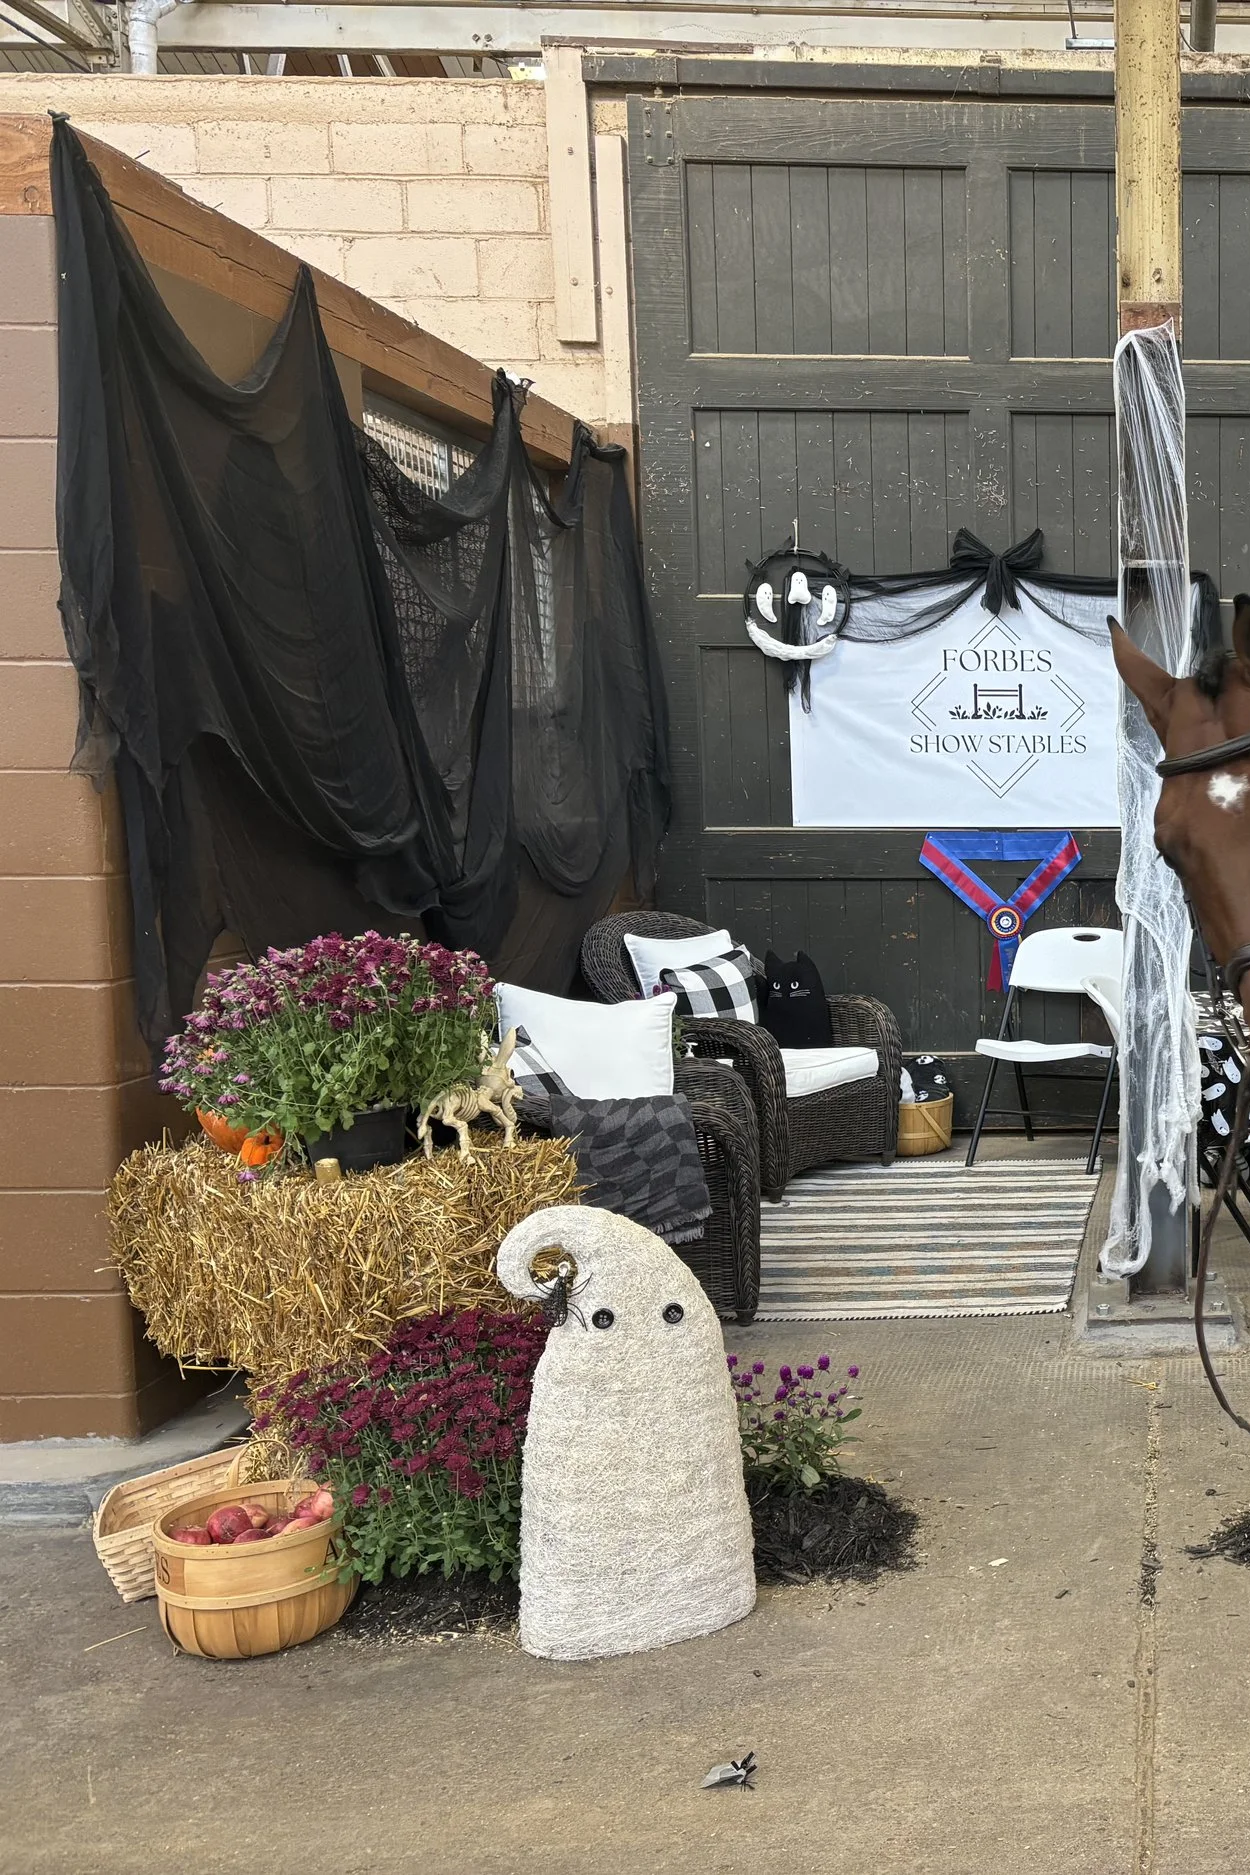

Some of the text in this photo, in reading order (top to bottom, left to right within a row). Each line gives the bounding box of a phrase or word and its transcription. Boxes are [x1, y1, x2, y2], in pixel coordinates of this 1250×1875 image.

[942, 649, 1052, 672] FORBES
[910, 734, 1087, 754] SHOW STABLES
